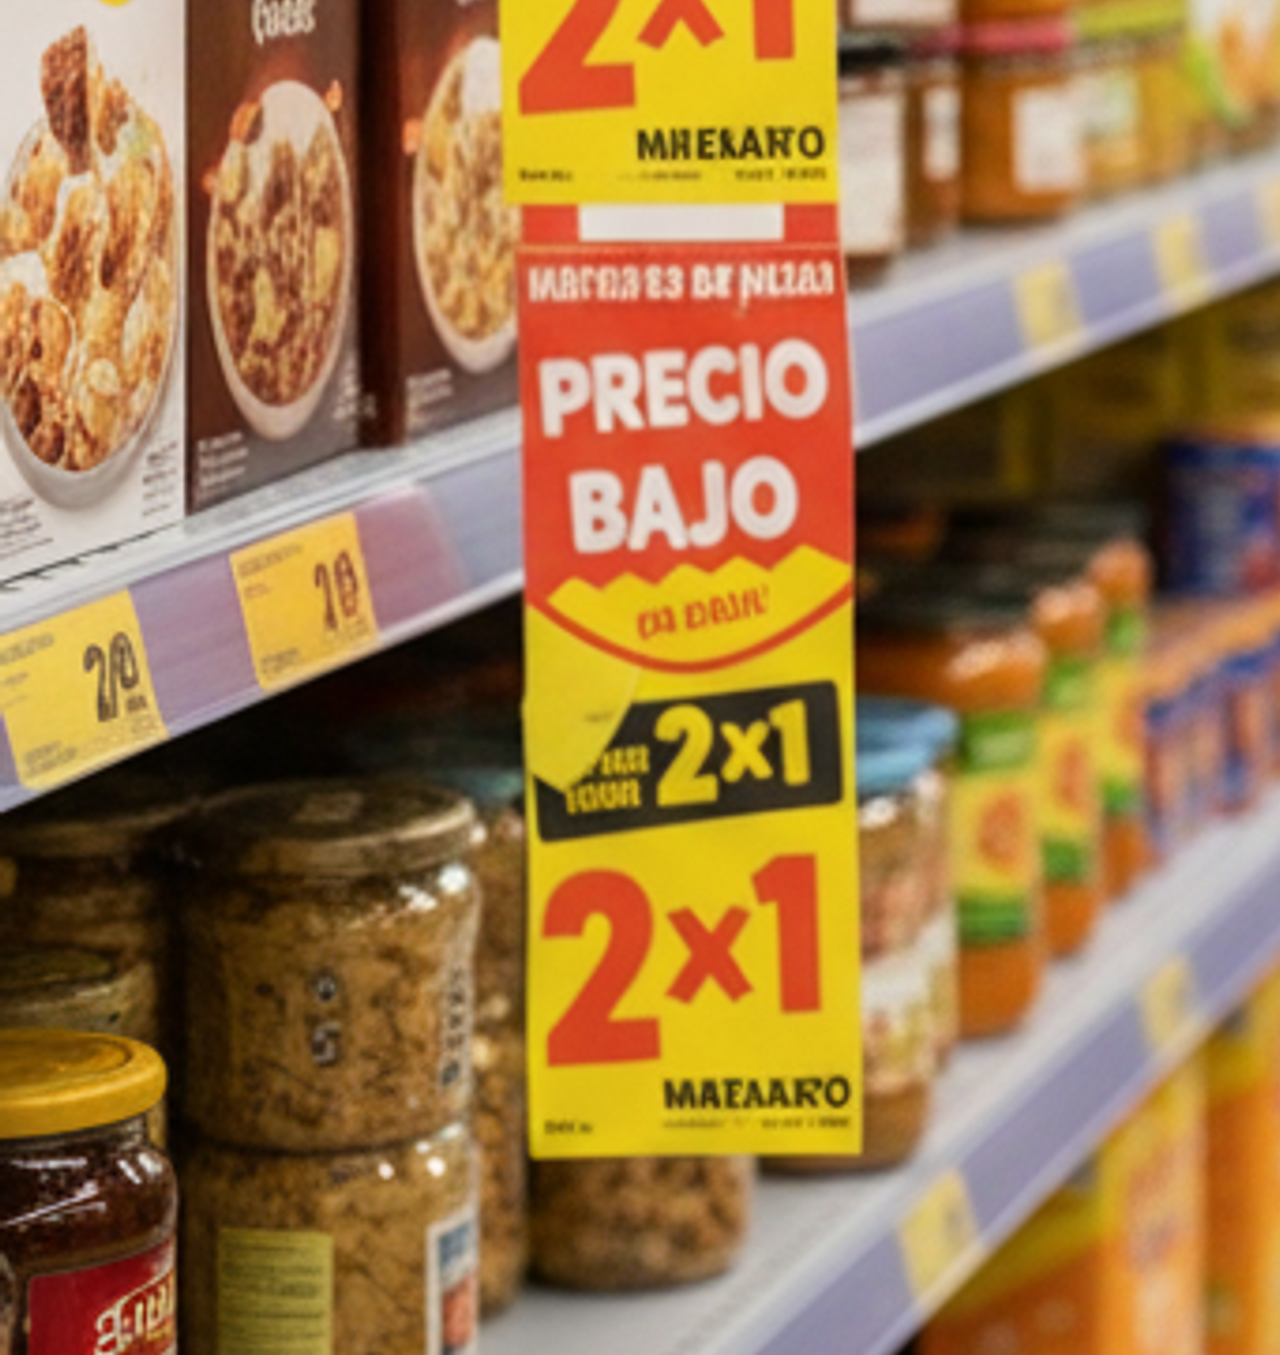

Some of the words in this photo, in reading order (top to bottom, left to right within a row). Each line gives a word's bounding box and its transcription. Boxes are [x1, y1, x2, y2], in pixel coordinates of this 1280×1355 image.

[538, 338, 829, 438] PRECIO
[568, 455, 798, 554] BAJO
[655, 699, 811, 808] 2x1
[542, 853, 821, 1067] 2x1
